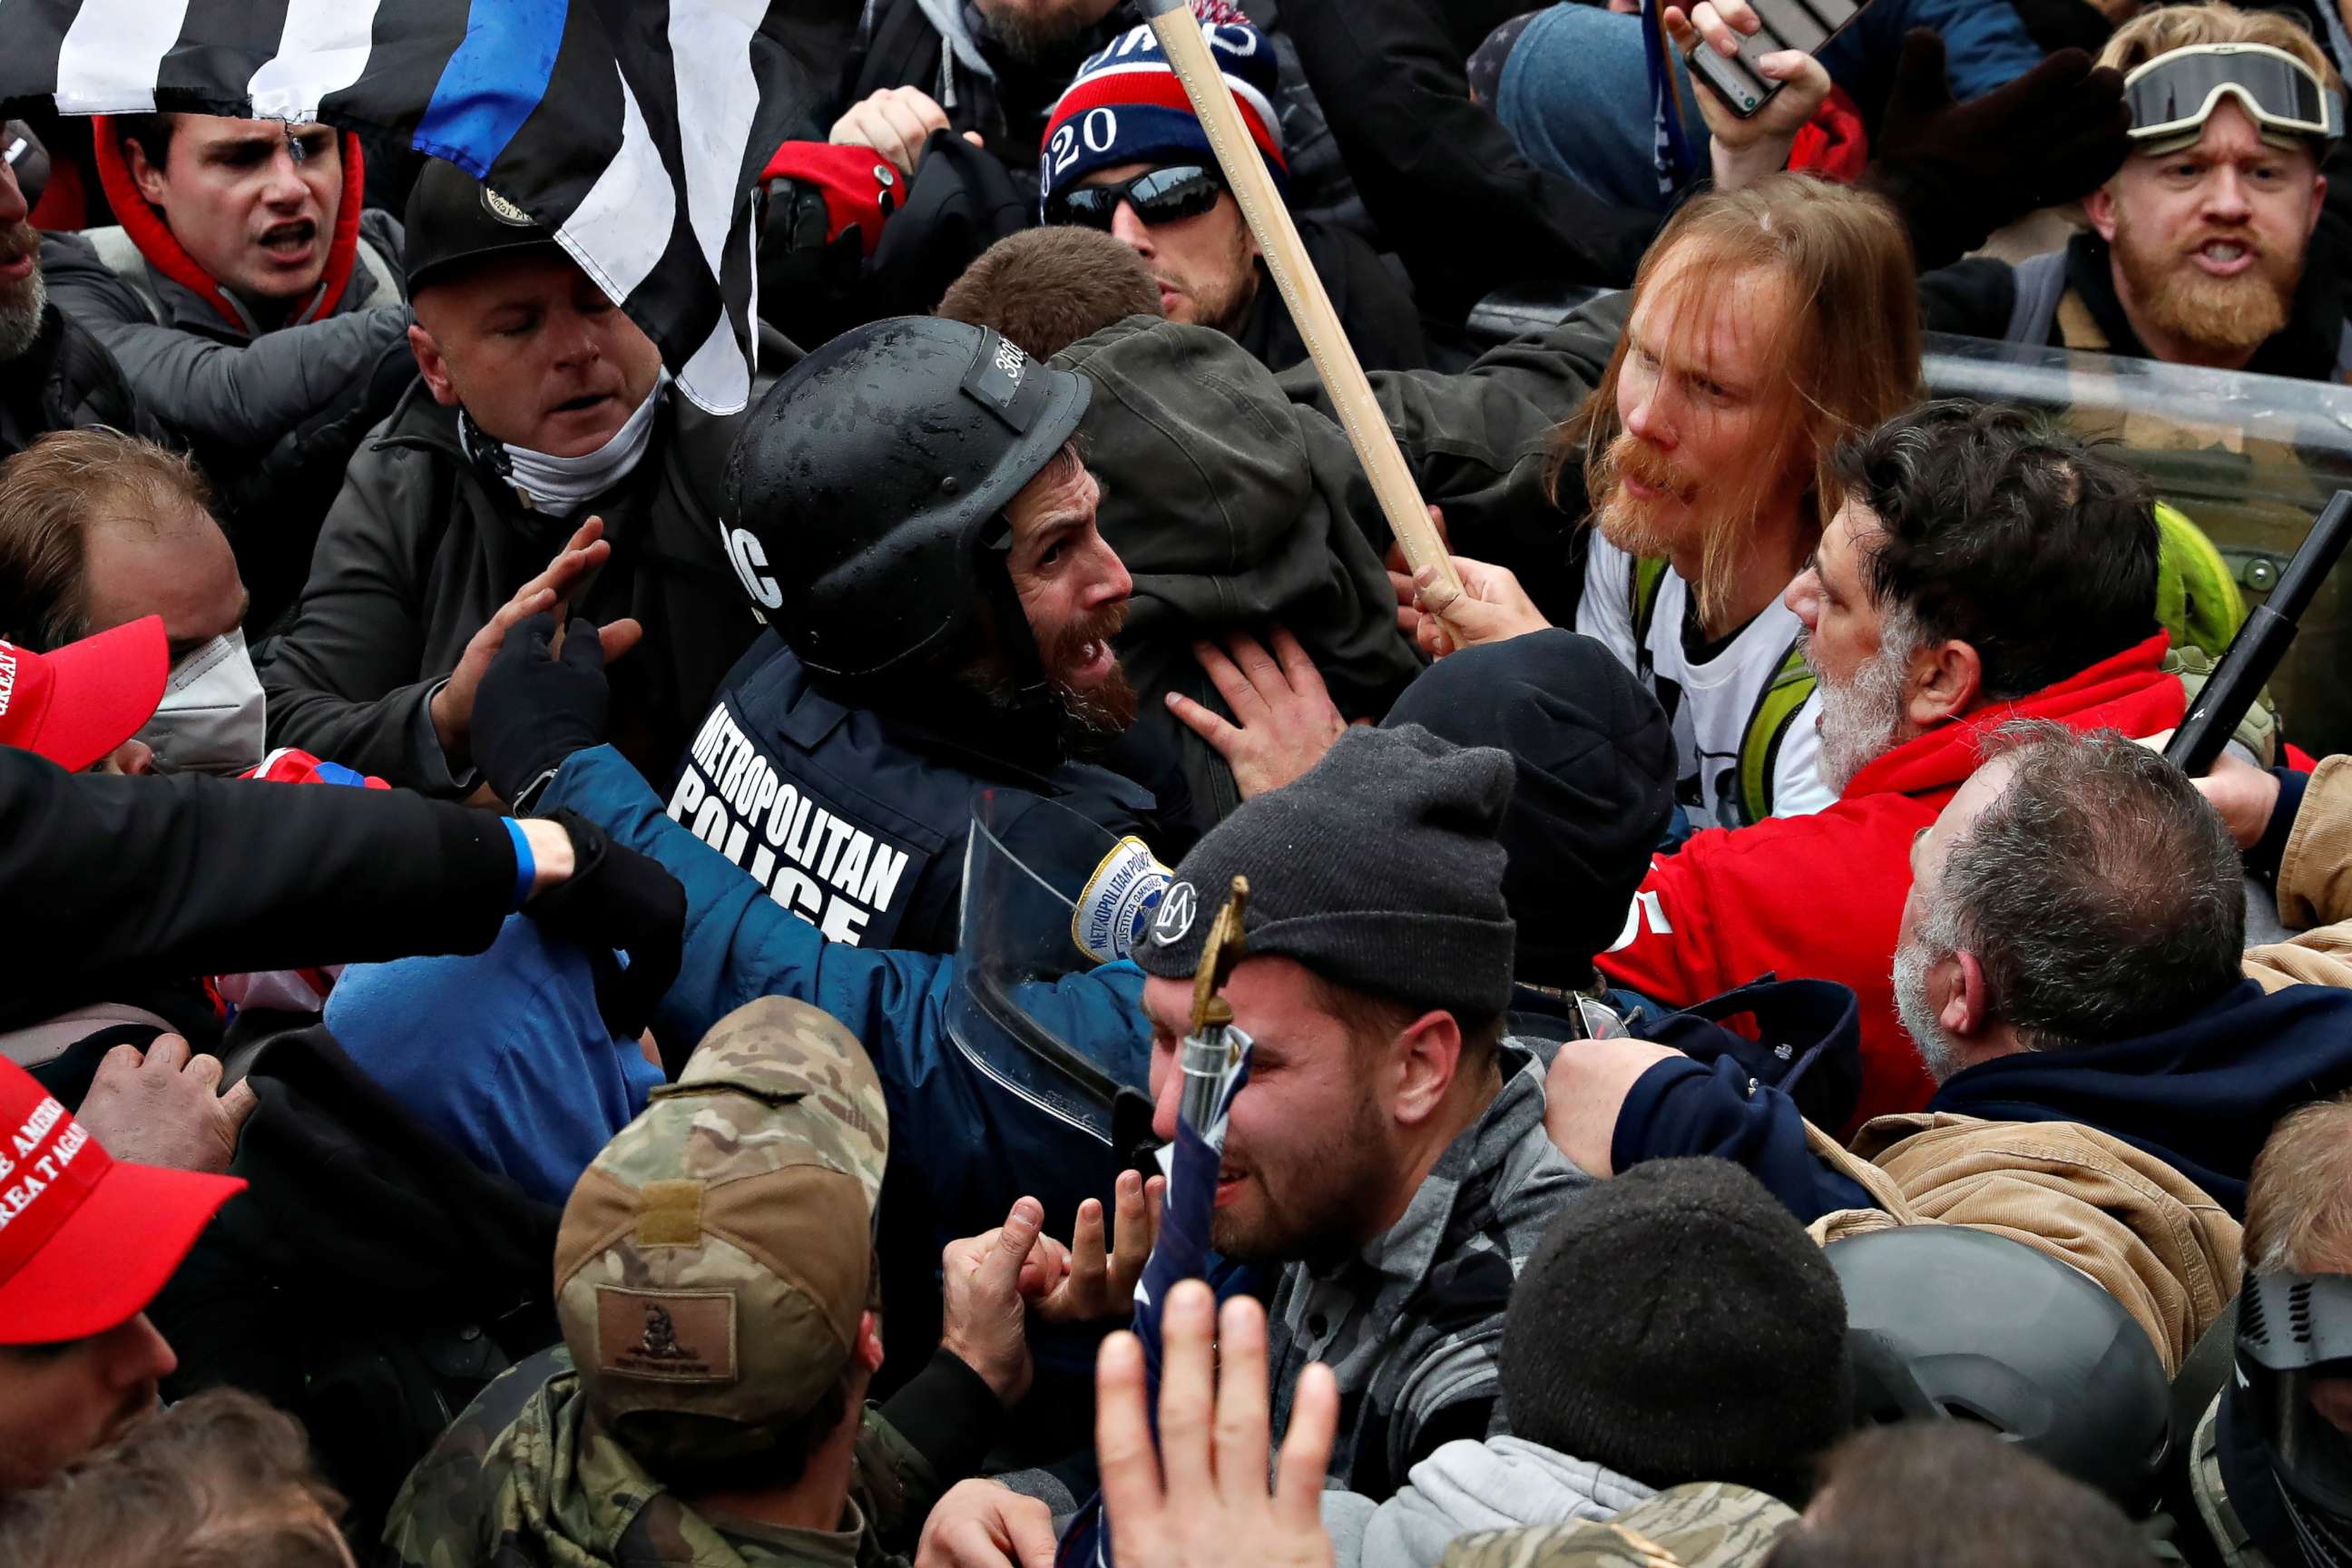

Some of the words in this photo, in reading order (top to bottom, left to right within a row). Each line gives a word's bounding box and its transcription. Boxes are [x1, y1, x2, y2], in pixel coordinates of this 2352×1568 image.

[1041, 107, 1117, 197] 020
[691, 701, 909, 913] METROPOLITAN
[1091, 867, 1132, 950] METROPOLITAN
[13, 1095, 66, 1159] AMERI
[0, 1154, 59, 1232] REAT
[52, 1122, 89, 1167] AGAI
